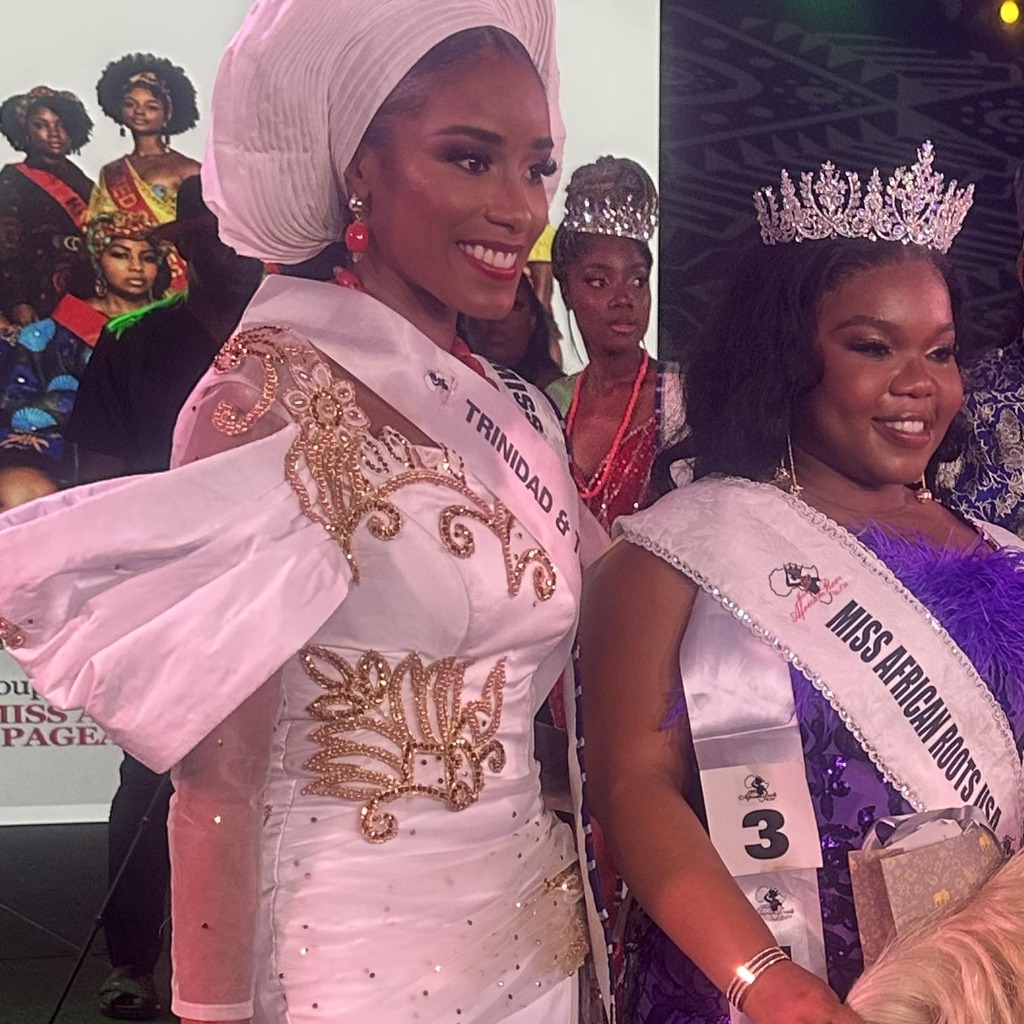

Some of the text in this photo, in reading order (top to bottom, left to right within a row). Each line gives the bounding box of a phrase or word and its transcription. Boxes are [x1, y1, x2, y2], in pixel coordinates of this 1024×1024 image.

[465, 398, 553, 513] TRINIDAD
[555, 509, 571, 536] &
[1, 726, 109, 747] PAGE
[825, 599, 893, 663] MISS
[872, 644, 952, 744] AFRICAN
[928, 723, 981, 802] ROOTS
[741, 808, 790, 860] 3
